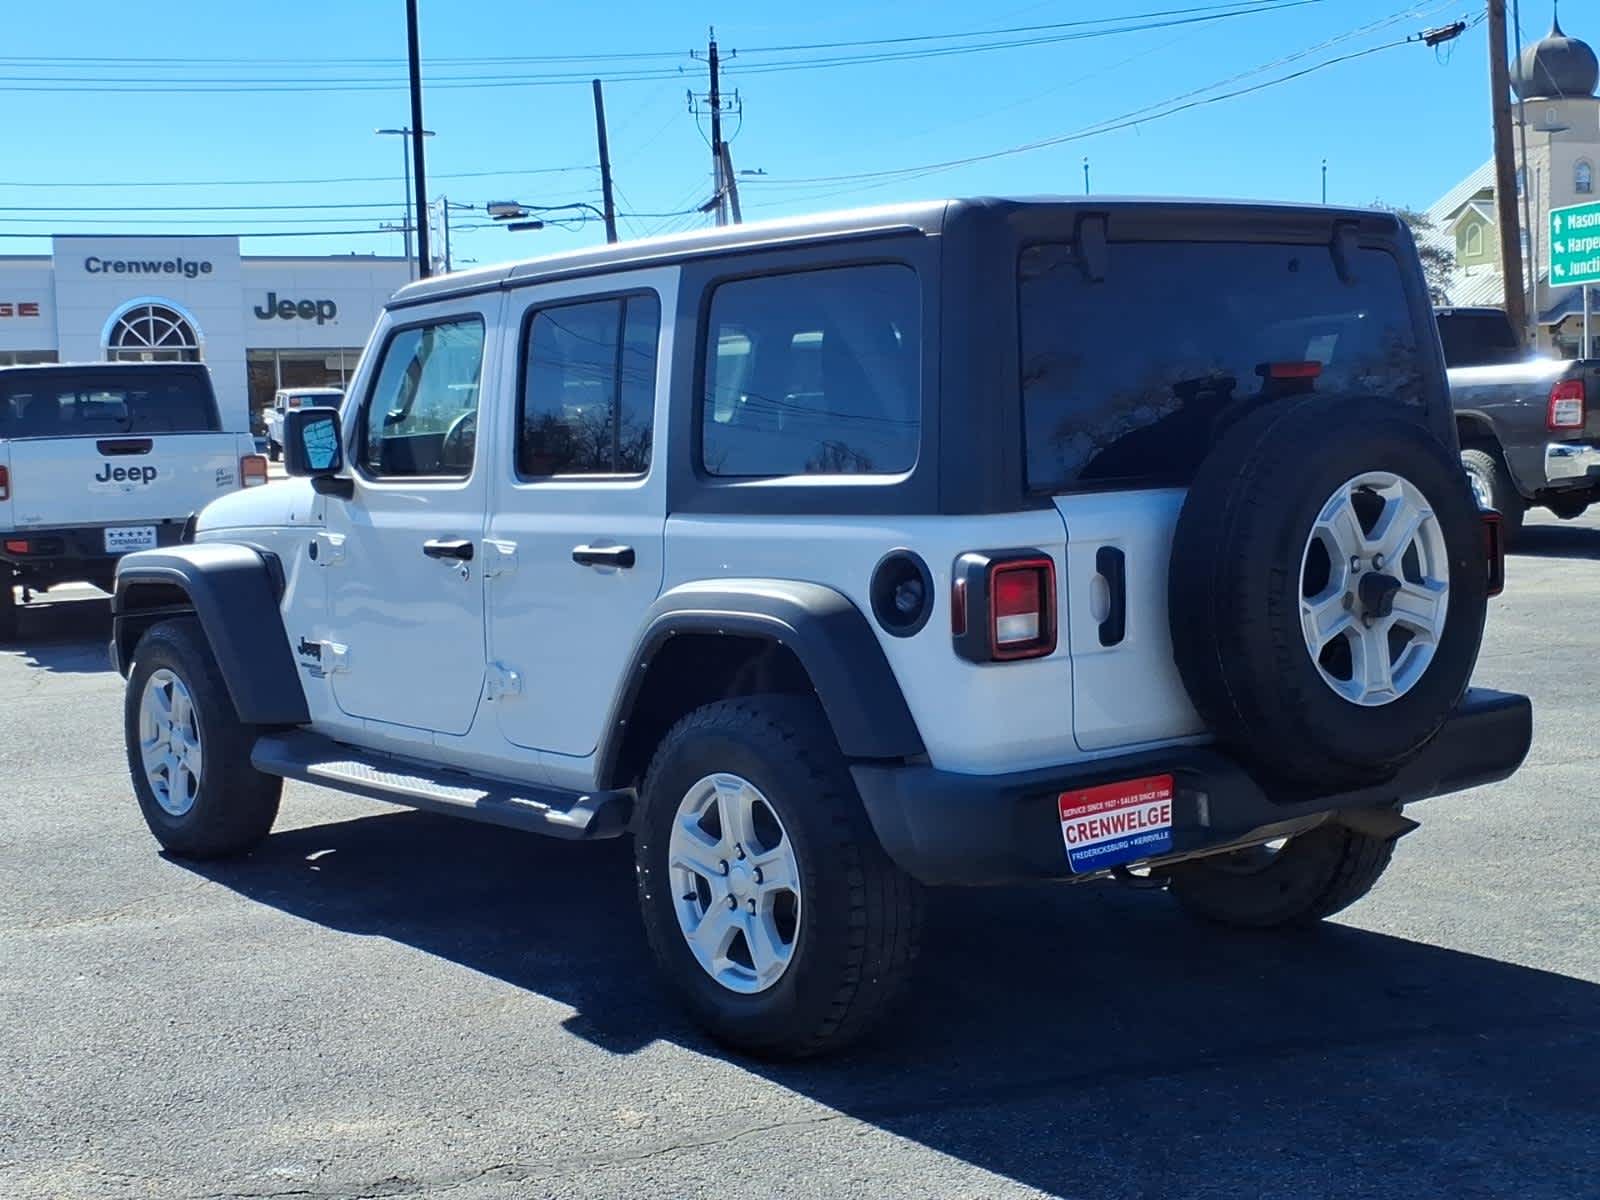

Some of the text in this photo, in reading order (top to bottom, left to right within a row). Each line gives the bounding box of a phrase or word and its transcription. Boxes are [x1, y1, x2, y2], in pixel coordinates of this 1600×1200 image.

[84, 256, 213, 279] Crenwelge
[254, 292, 337, 325] Jeep
[95, 463, 158, 485] Jeep
[1087, 801, 1104, 813] SINCE
[1120, 794, 1138, 805] SALES
[1139, 791, 1156, 802] SINCE
[1066, 805, 1170, 844] CRENWELGE
[1072, 832, 1169, 861] FREDERICKSBURG KERRVILLE
